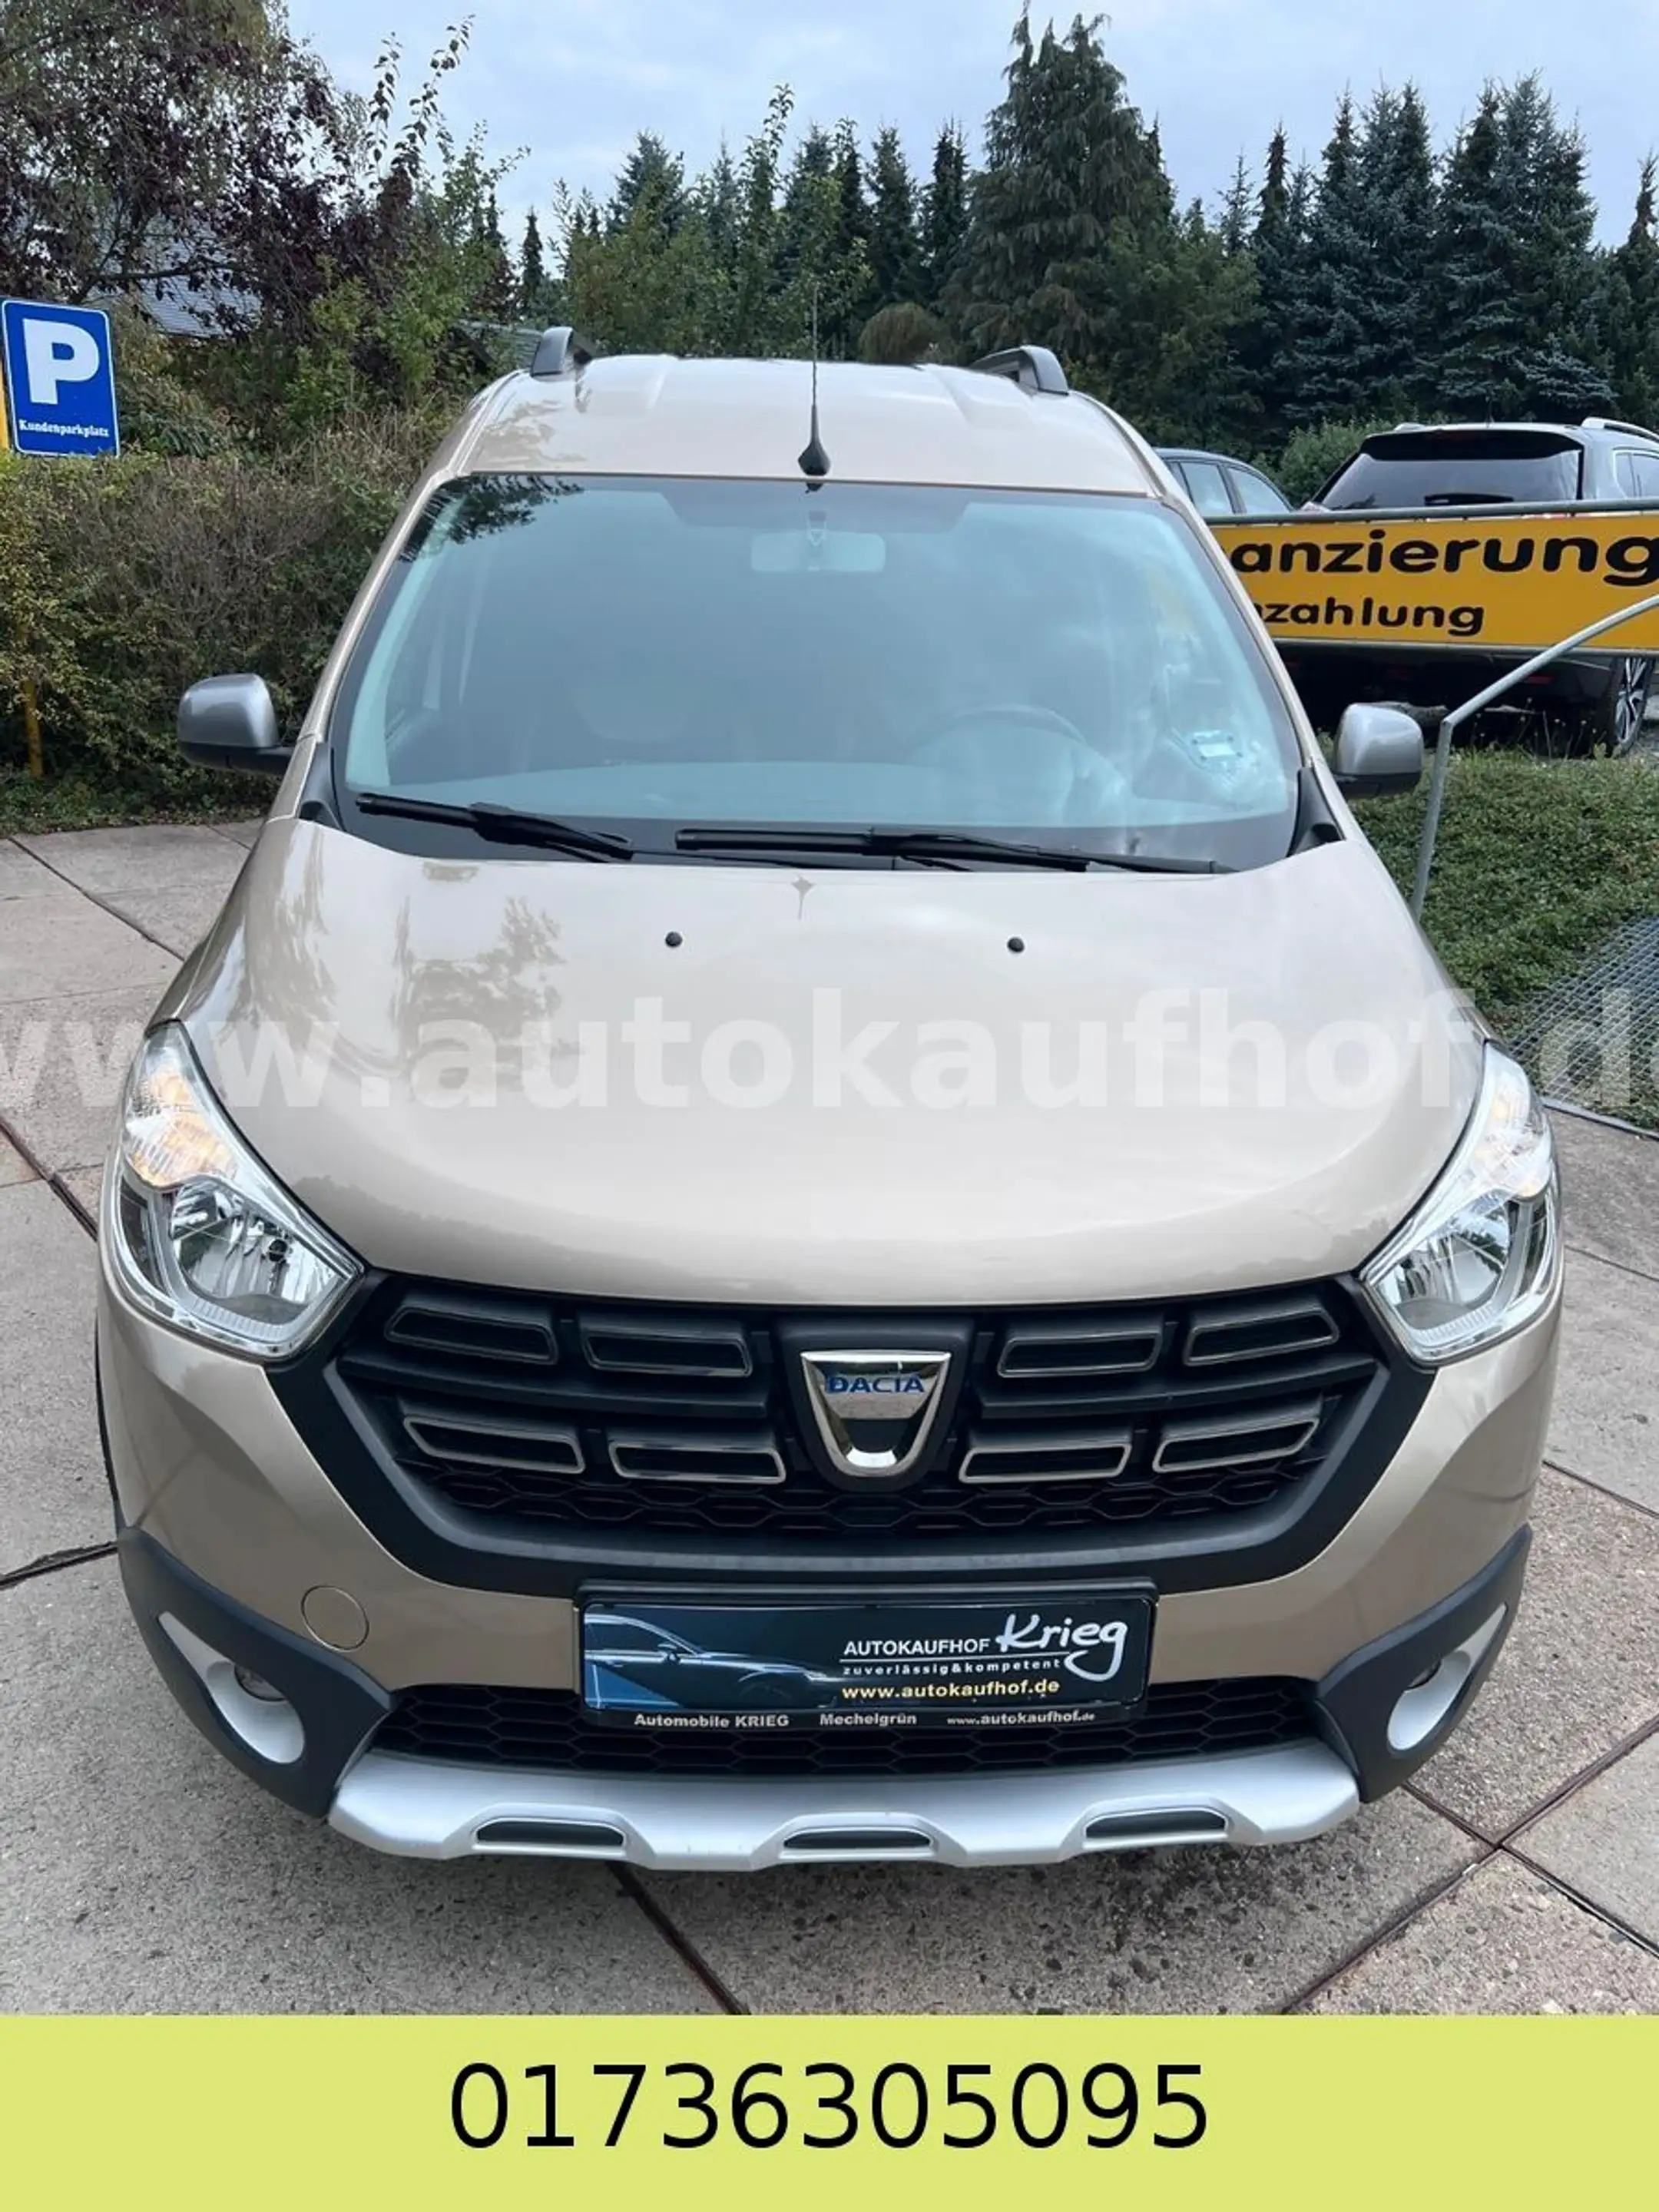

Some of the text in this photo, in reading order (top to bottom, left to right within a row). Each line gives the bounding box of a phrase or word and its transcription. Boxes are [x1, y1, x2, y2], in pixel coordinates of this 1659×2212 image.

[22, 318, 100, 405] P
[18, 419, 110, 438] Kundenparkplatz
[1220, 529, 1659, 587] anzierung
[826, 1376, 925, 1393] DACIA
[843, 1614, 1128, 1682] AUTOKAUFHOF Krieg
[842, 1679, 1061, 1700] www.autokaufhof.de
[634, 1709, 1095, 1728] Automobile KRIEG Mechelgrün www.autokaufhof.de
